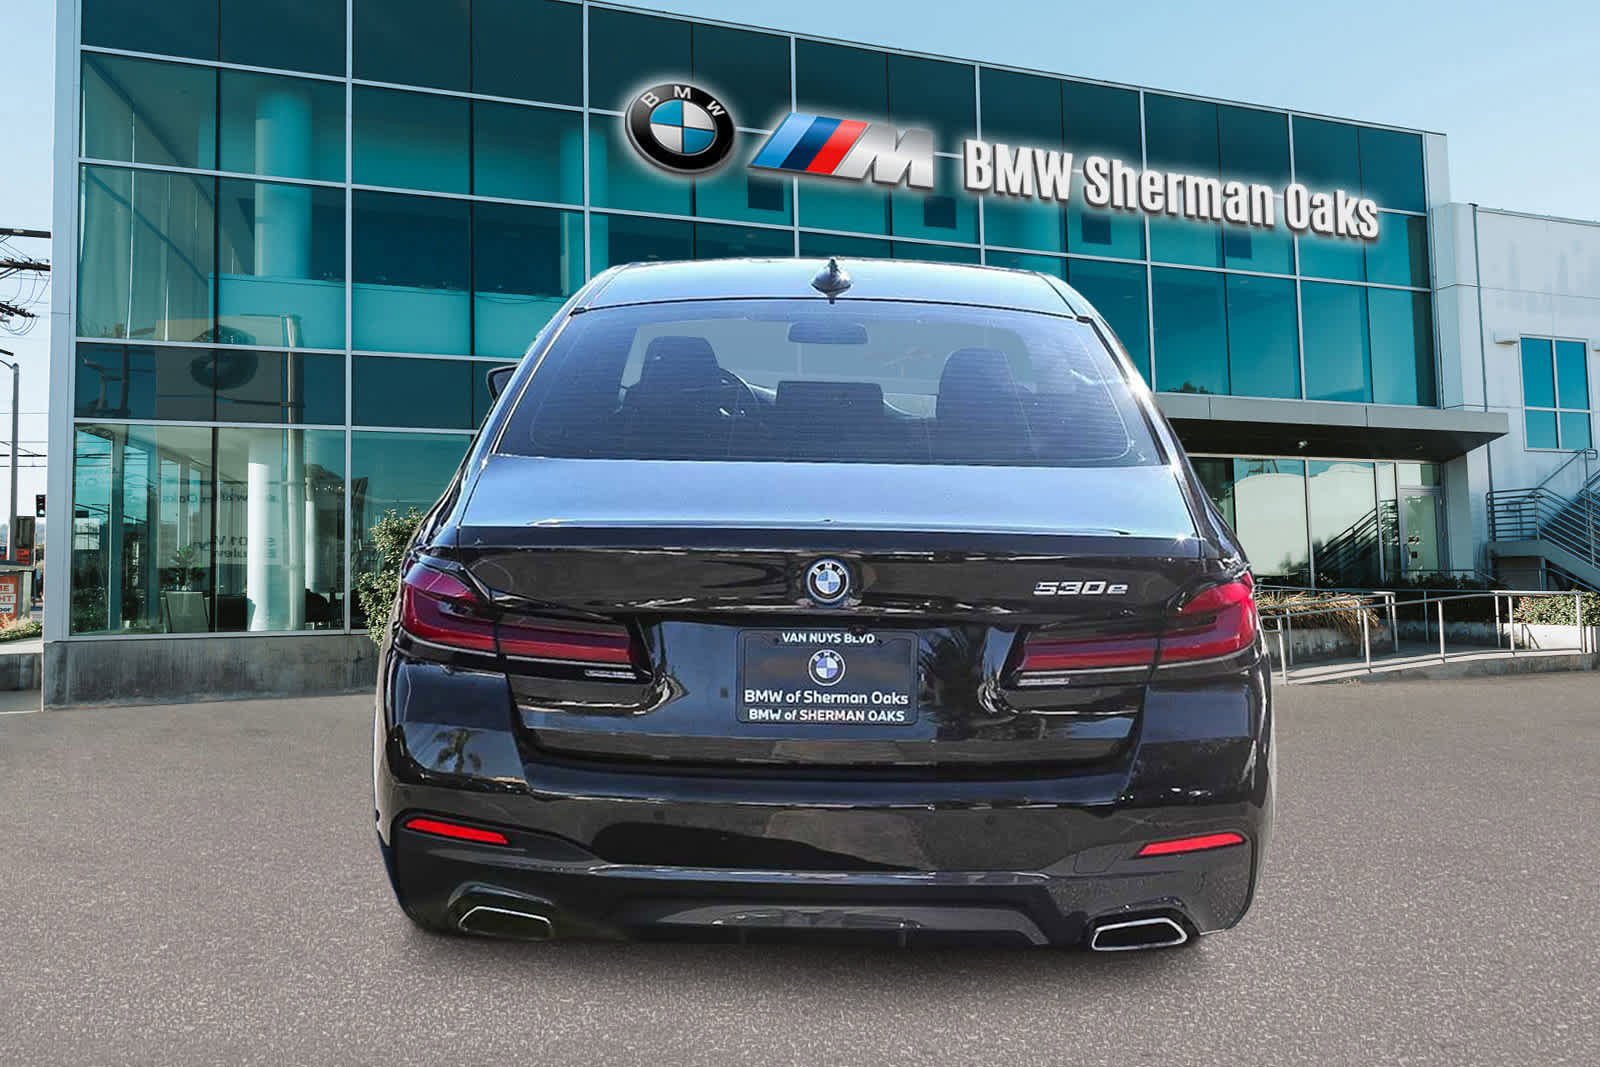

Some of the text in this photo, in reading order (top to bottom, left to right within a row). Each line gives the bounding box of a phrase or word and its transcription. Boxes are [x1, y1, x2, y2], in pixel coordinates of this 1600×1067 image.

[640, 85, 726, 117] BMW
[963, 138, 1380, 242] BMW Sherman Oaks
[1033, 581, 1128, 595] 530e
[782, 632, 807, 643] VAN
[809, 633, 841, 643] NUYS
[744, 690, 909, 705] BMW of Sherman Oaks
[749, 709, 905, 722] BMW of SHERMAN OAKS
